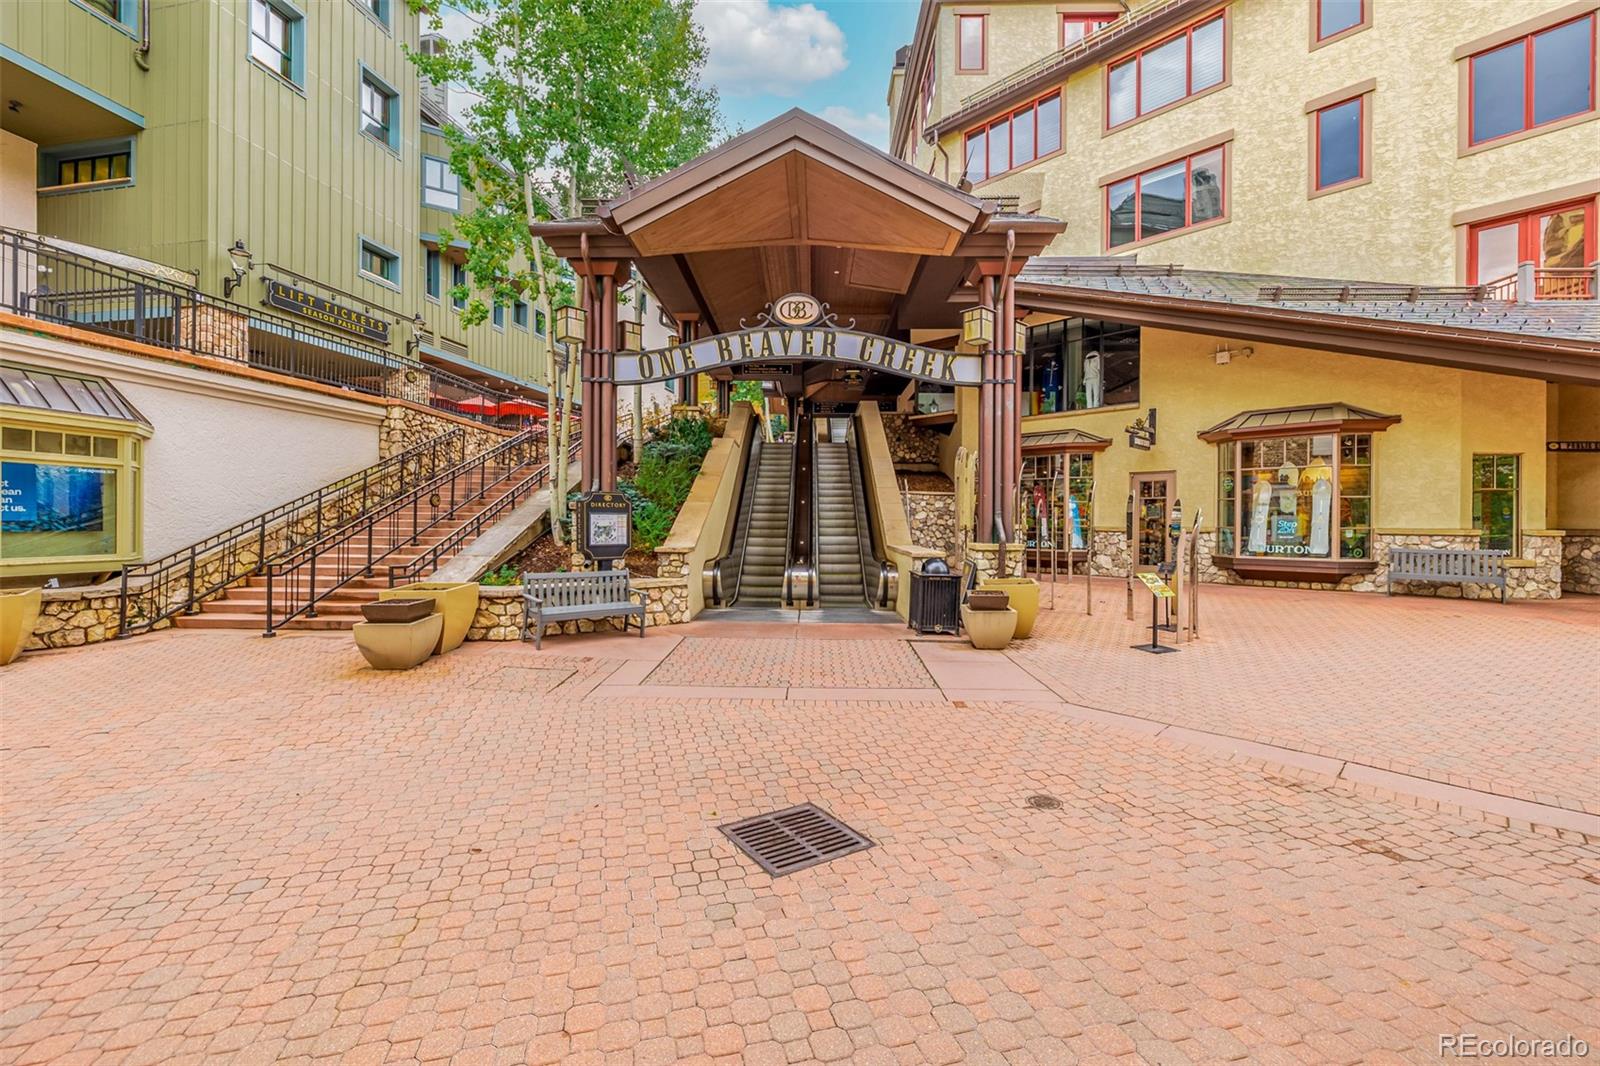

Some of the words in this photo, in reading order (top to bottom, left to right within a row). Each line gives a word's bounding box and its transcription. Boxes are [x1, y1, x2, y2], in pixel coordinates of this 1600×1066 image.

[278, 286, 315, 306] LIFT
[324, 303, 383, 331] TICKETS
[302, 307, 335, 323] SEASON
[338, 319, 365, 333] PASSES
[638, 346, 697, 380] ONE
[714, 330, 837, 362] BEAVER
[859, 335, 958, 382] CREEK
[1256, 545, 1316, 554] URTON
